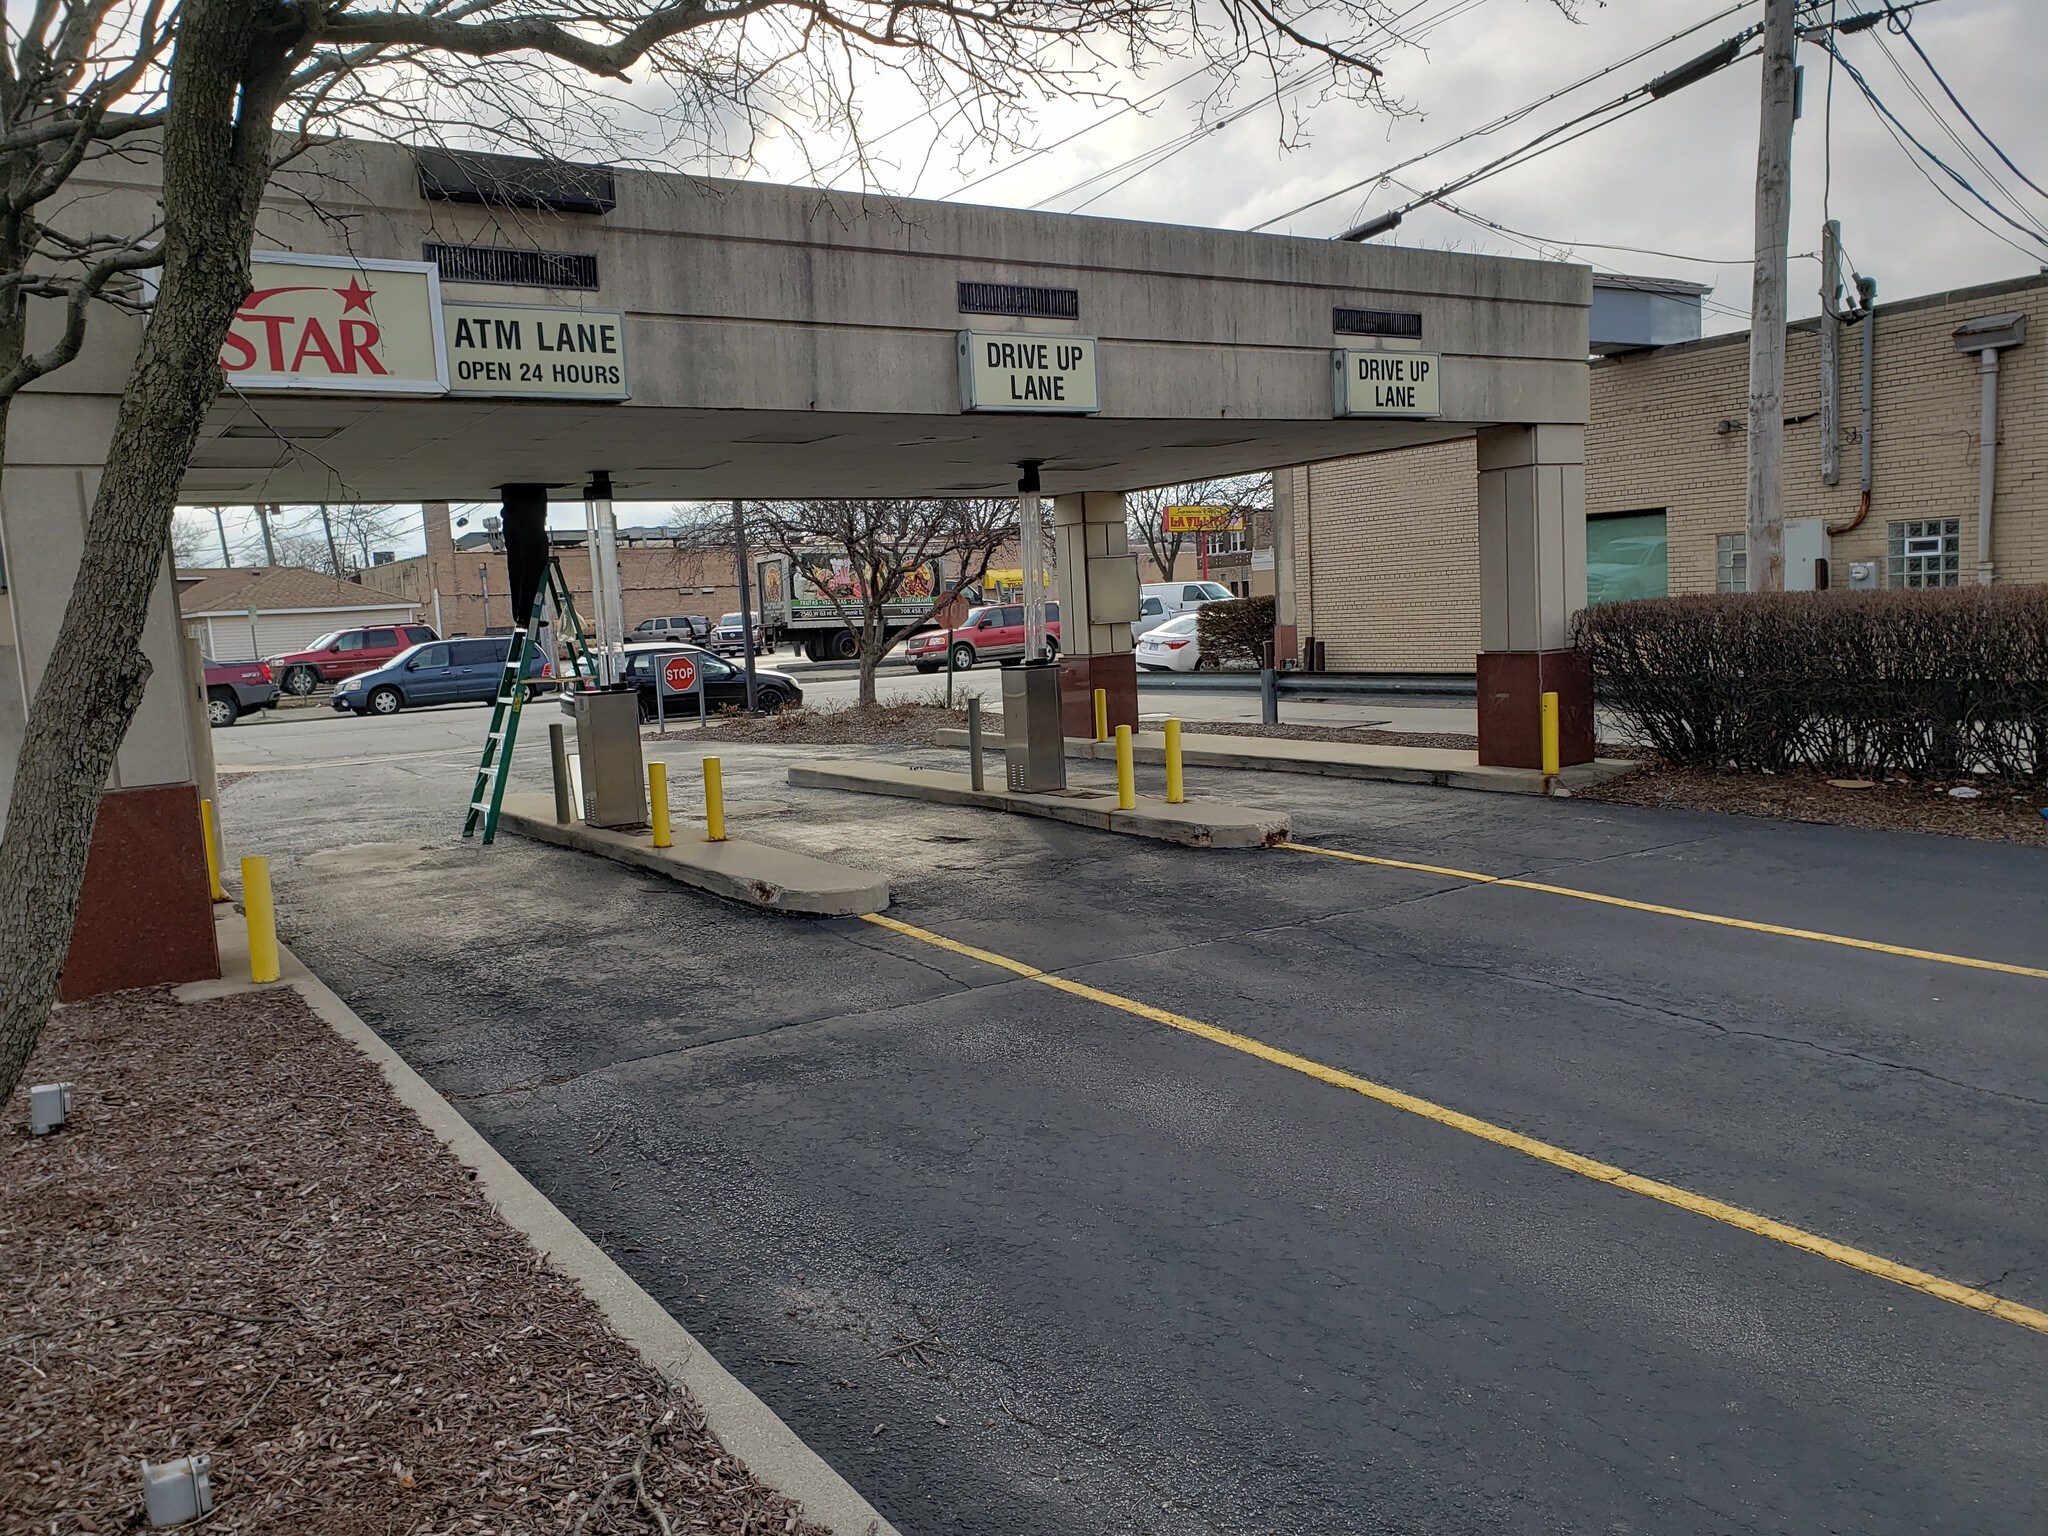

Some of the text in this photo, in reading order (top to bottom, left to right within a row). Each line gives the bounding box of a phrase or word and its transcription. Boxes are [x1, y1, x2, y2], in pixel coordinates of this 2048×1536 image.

[219, 312, 388, 375] STAR
[455, 318, 617, 354] ATM LANE
[987, 342, 1083, 371] DRIVE UP
[458, 360, 620, 384] OPEN 24 HOURS
[1359, 358, 1430, 382] DRIVE UP
[1010, 374, 1065, 401] LANE
[1375, 385, 1416, 408] LANE
[1170, 516, 1186, 527] LA
[666, 667, 694, 681] STOP
